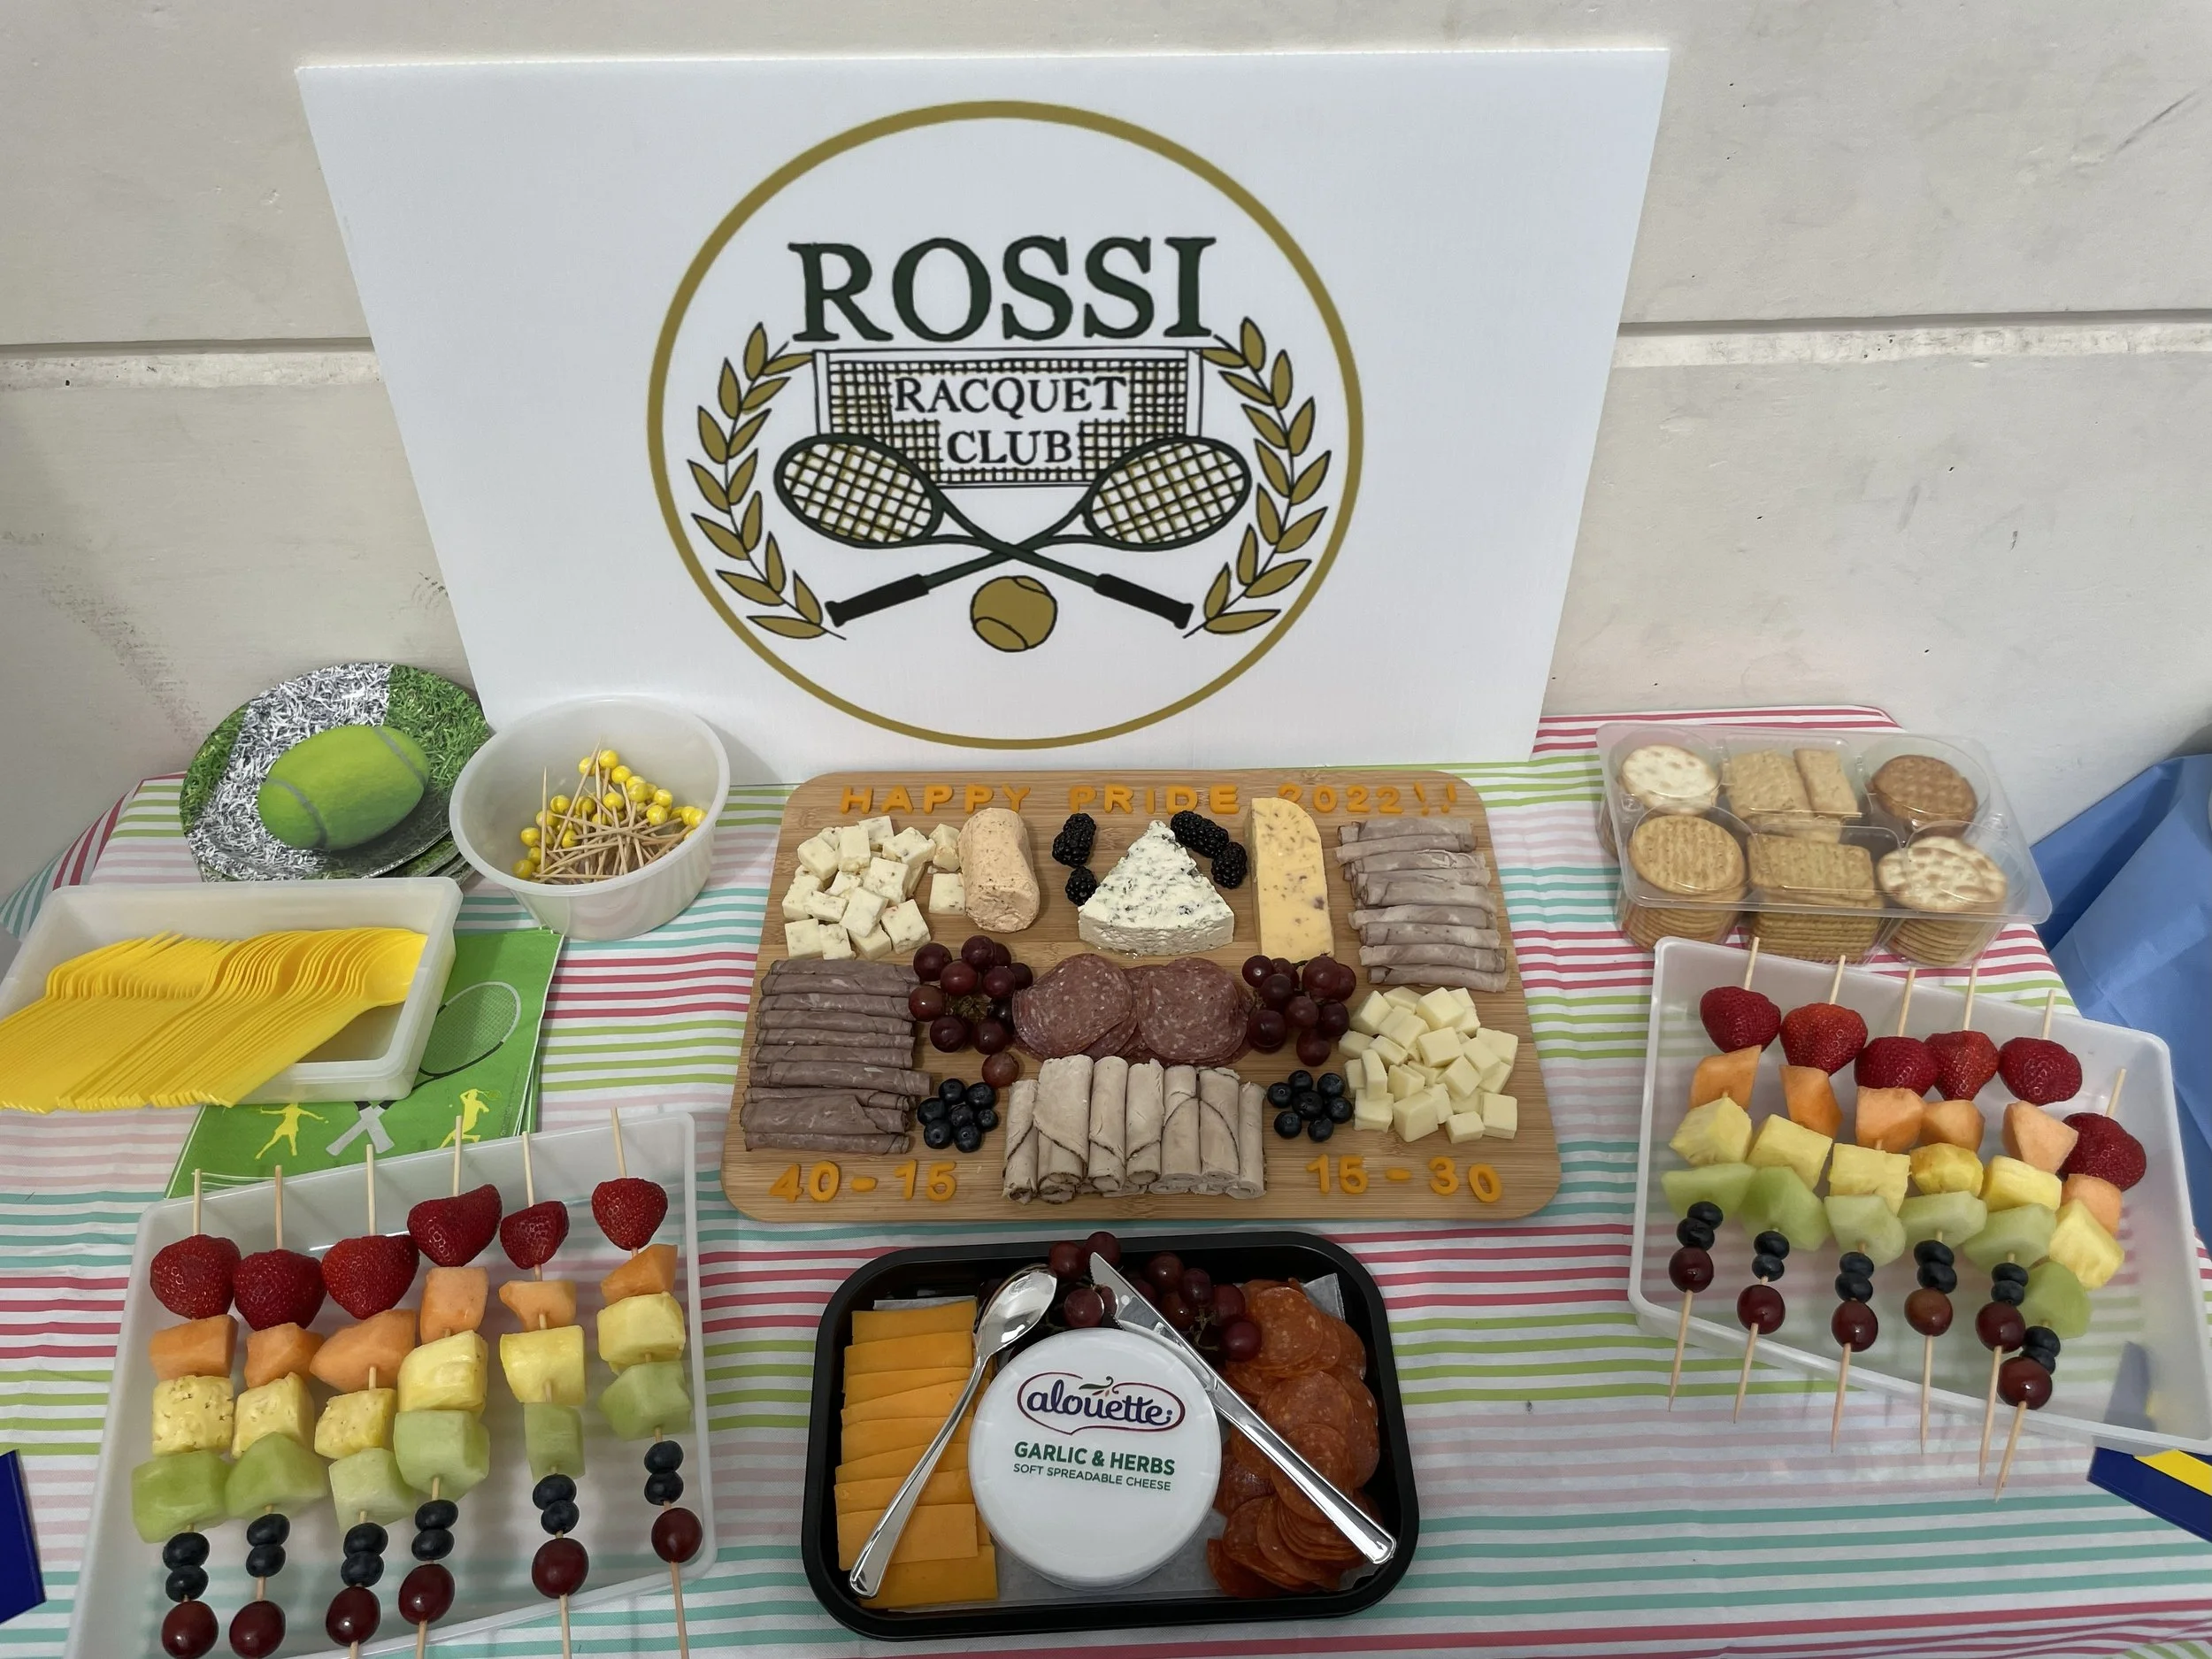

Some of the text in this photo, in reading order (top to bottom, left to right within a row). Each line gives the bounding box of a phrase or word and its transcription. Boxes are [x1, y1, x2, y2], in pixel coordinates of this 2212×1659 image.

[787, 235, 1217, 342] ROSSI
[894, 375, 1127, 419] RACQUET
[947, 430, 1073, 465] CLUB
[841, 782, 1031, 814] HAPPY
[1068, 783, 1240, 815] PRIDE
[1026, 1379, 1172, 1425] alouette
[1014, 1441, 1175, 1475] GARLIC & HERBS
[1013, 1463, 1171, 1491] SOFT SPREADABLE CHEESE
